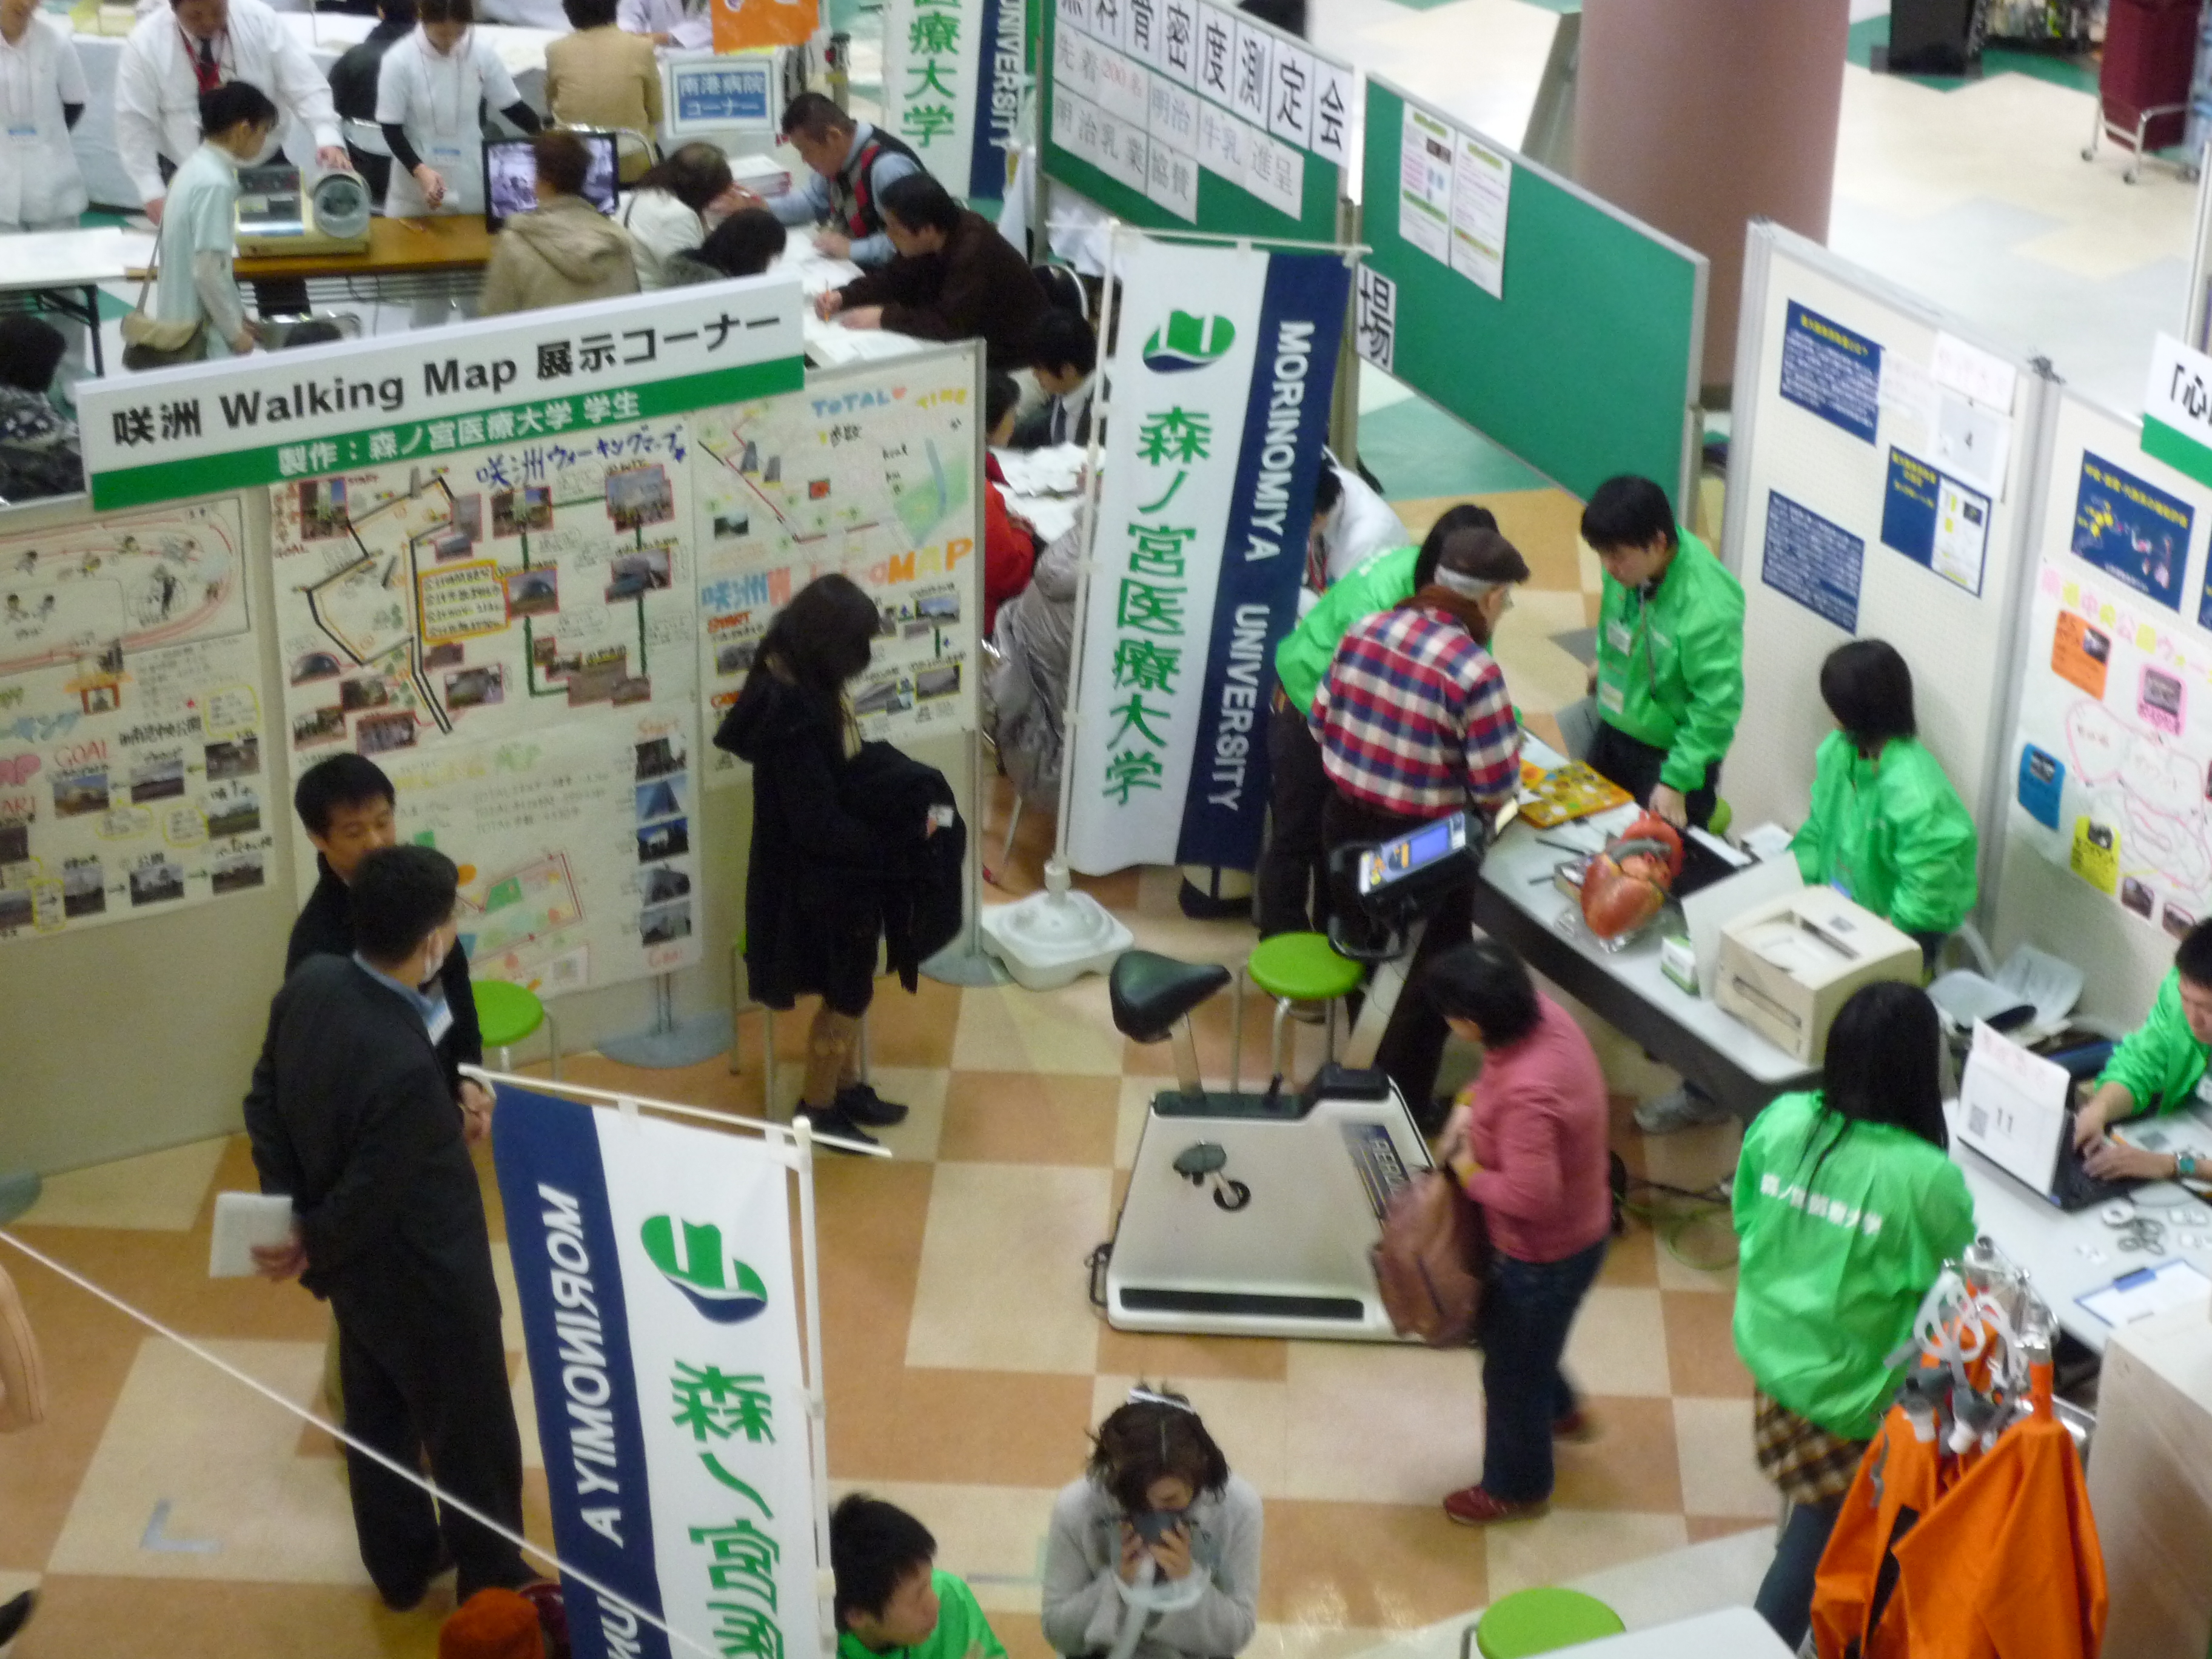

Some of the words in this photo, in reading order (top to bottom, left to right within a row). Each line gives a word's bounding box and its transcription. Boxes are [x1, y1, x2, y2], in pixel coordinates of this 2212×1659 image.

[686, 96, 760, 117] コーナー
[1060, 0, 1346, 152] 料骨密度測定会
[112, 398, 201, 447] 咲洲
[219, 376, 404, 429] Walking
[424, 358, 517, 395] Map
[537, 312, 781, 380] 展示コーナー
[583, 391, 641, 424] 学生
[1245, 320, 1315, 561] MORINOMIYA
[2170, 362, 2212, 426] 「心
[1102, 404, 1213, 806] 森ノ宮医療大学
[1208, 606, 1270, 811] UNIVERSITY
